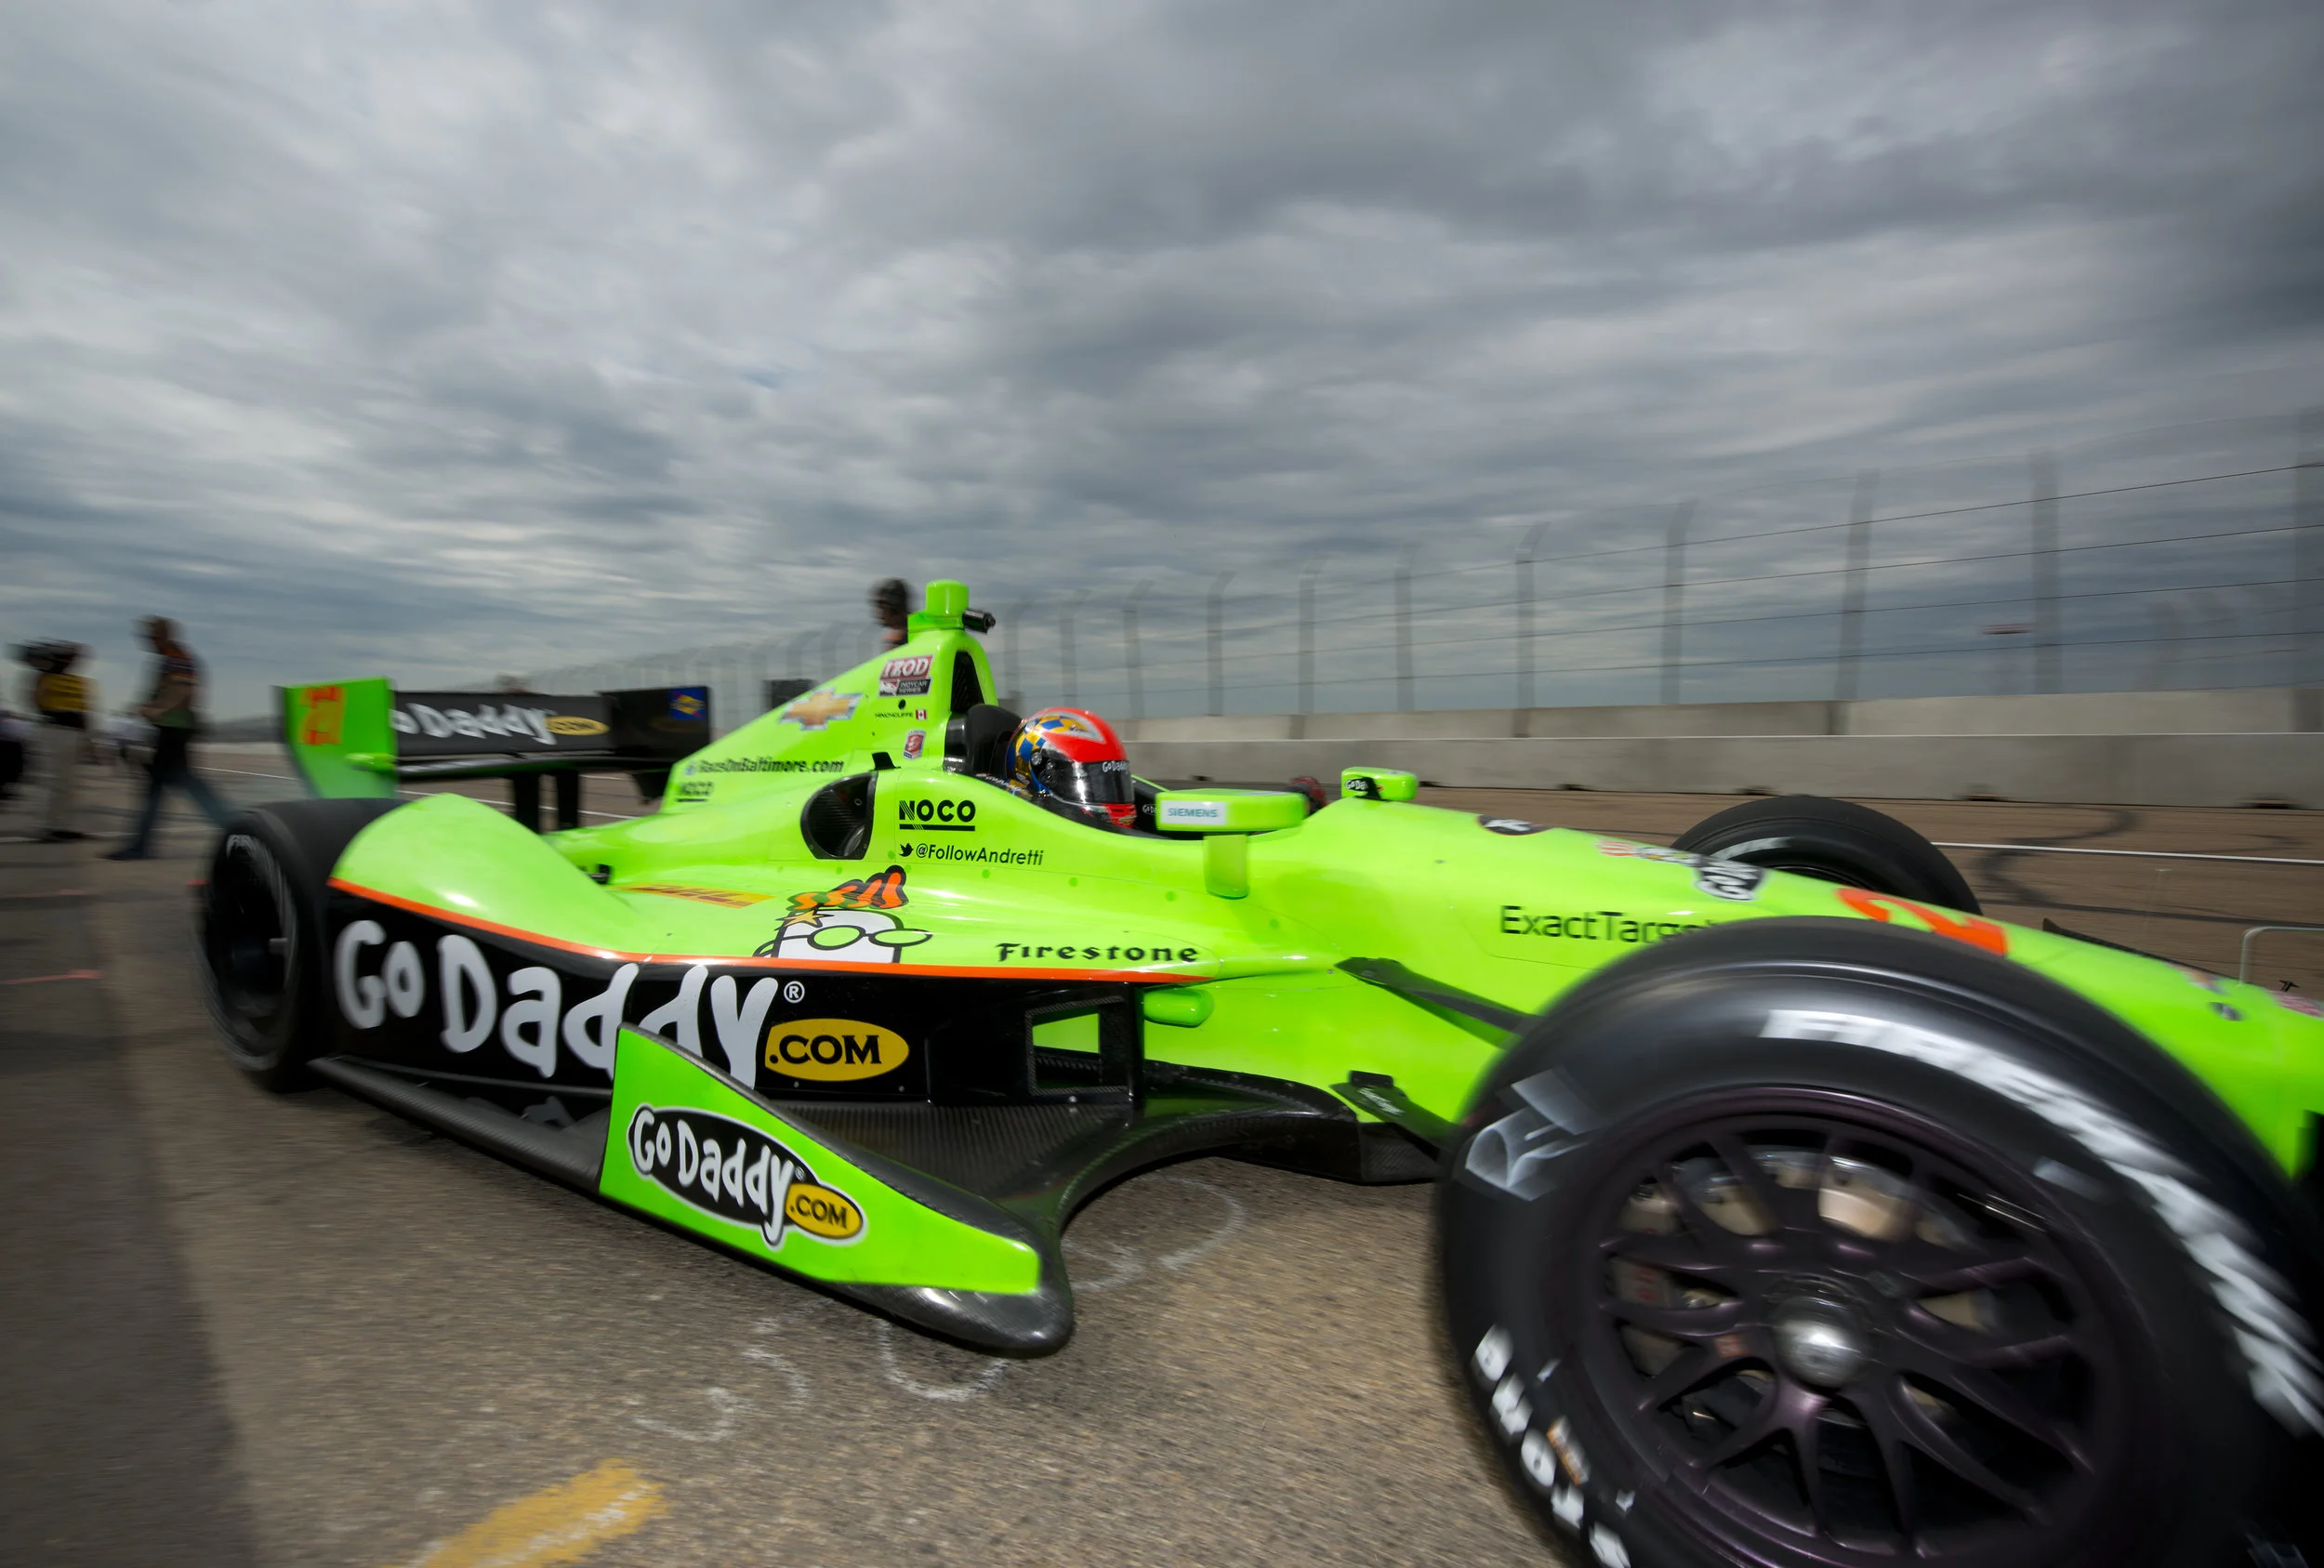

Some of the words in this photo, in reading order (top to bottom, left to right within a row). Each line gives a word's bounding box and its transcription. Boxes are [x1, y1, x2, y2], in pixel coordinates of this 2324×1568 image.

[899, 799, 976, 823] NOCO
[1167, 807, 1219, 818] SIEMENS
[916, 842, 1044, 866] @FollowAndretti
[997, 942, 1199, 964] Firestone
[769, 1034, 882, 1066] .COM
[790, 1193, 848, 1230] .COM
